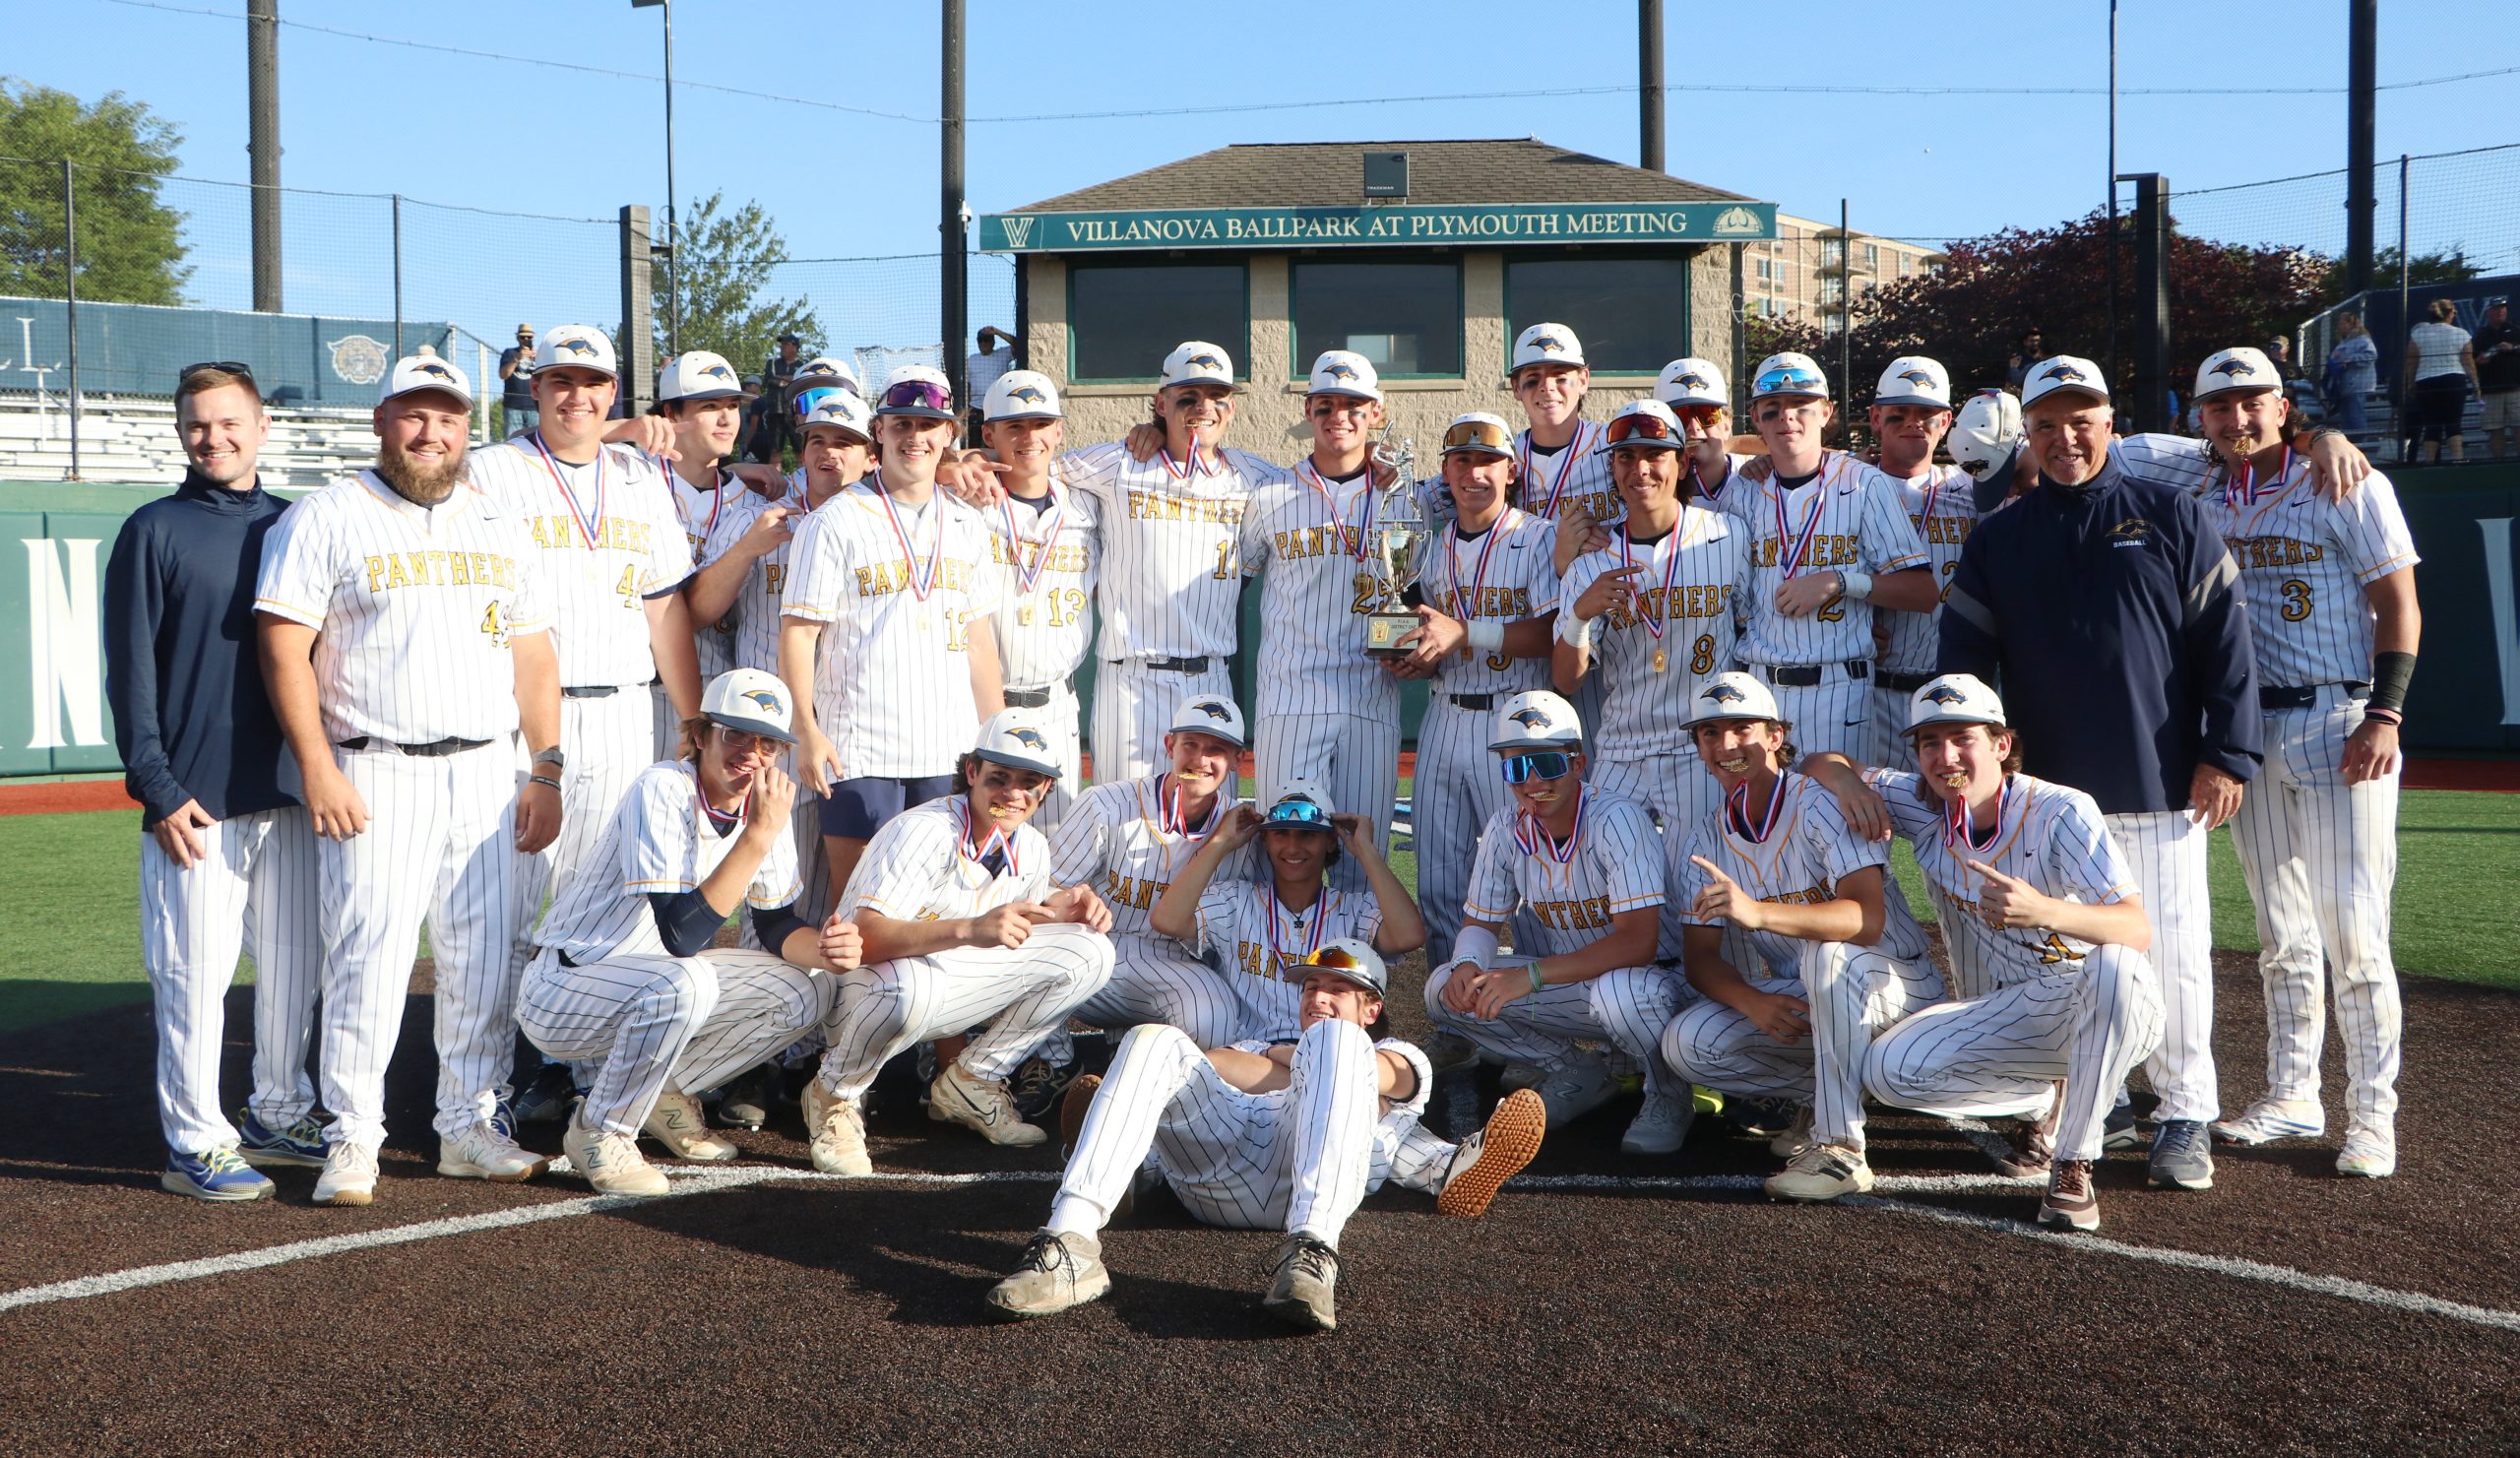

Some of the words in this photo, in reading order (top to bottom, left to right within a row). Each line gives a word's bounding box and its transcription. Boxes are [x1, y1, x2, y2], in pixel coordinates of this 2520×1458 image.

[1067, 219, 1220, 242] VILLANOVA
[1226, 216, 1361, 238] BALLPARK
[1367, 216, 1405, 237] AT
[1411, 214, 1559, 237] PLYMOUTH
[1566, 212, 1688, 235] MEETING
[0, 317, 61, 372] L
[2112, 539, 2147, 548] BASEBALL
[365, 549, 516, 593] PANTHERS
[2280, 579, 2313, 622] 3
[1690, 633, 1716, 675] 8
